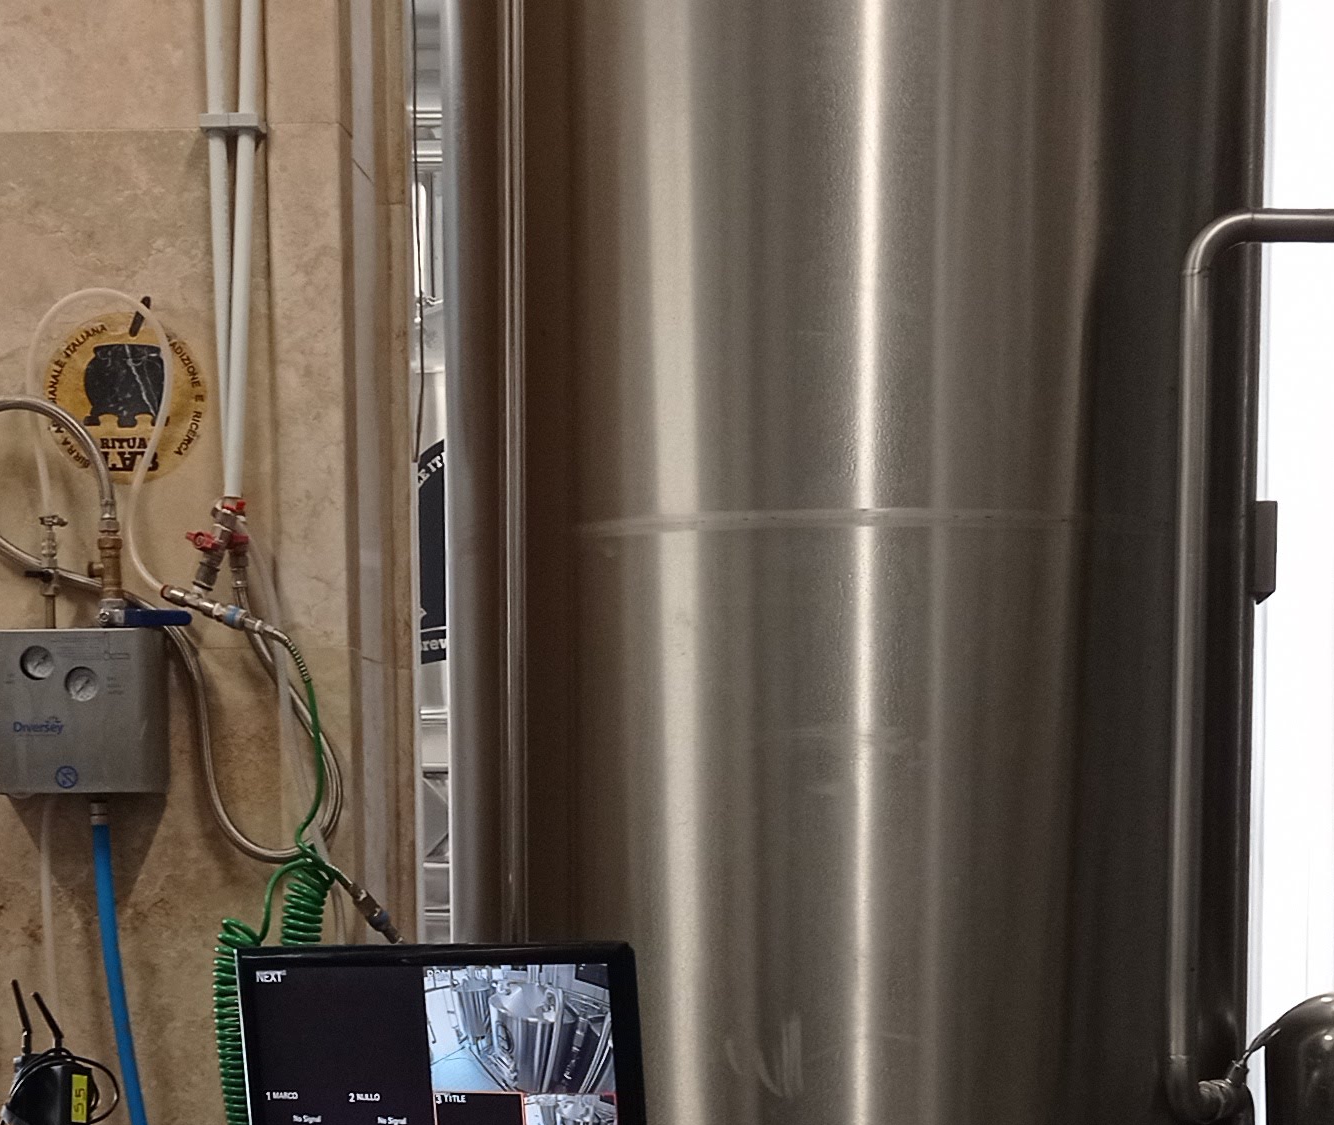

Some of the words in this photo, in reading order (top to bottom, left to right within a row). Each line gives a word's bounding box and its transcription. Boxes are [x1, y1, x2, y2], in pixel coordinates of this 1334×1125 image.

[63, 324, 108, 359] ITALIANA
[195, 394, 205, 403] E
[173, 410, 203, 457] RICERCA
[100, 437, 149, 449] RITUA
[444, 1095, 467, 1104] TITLE
